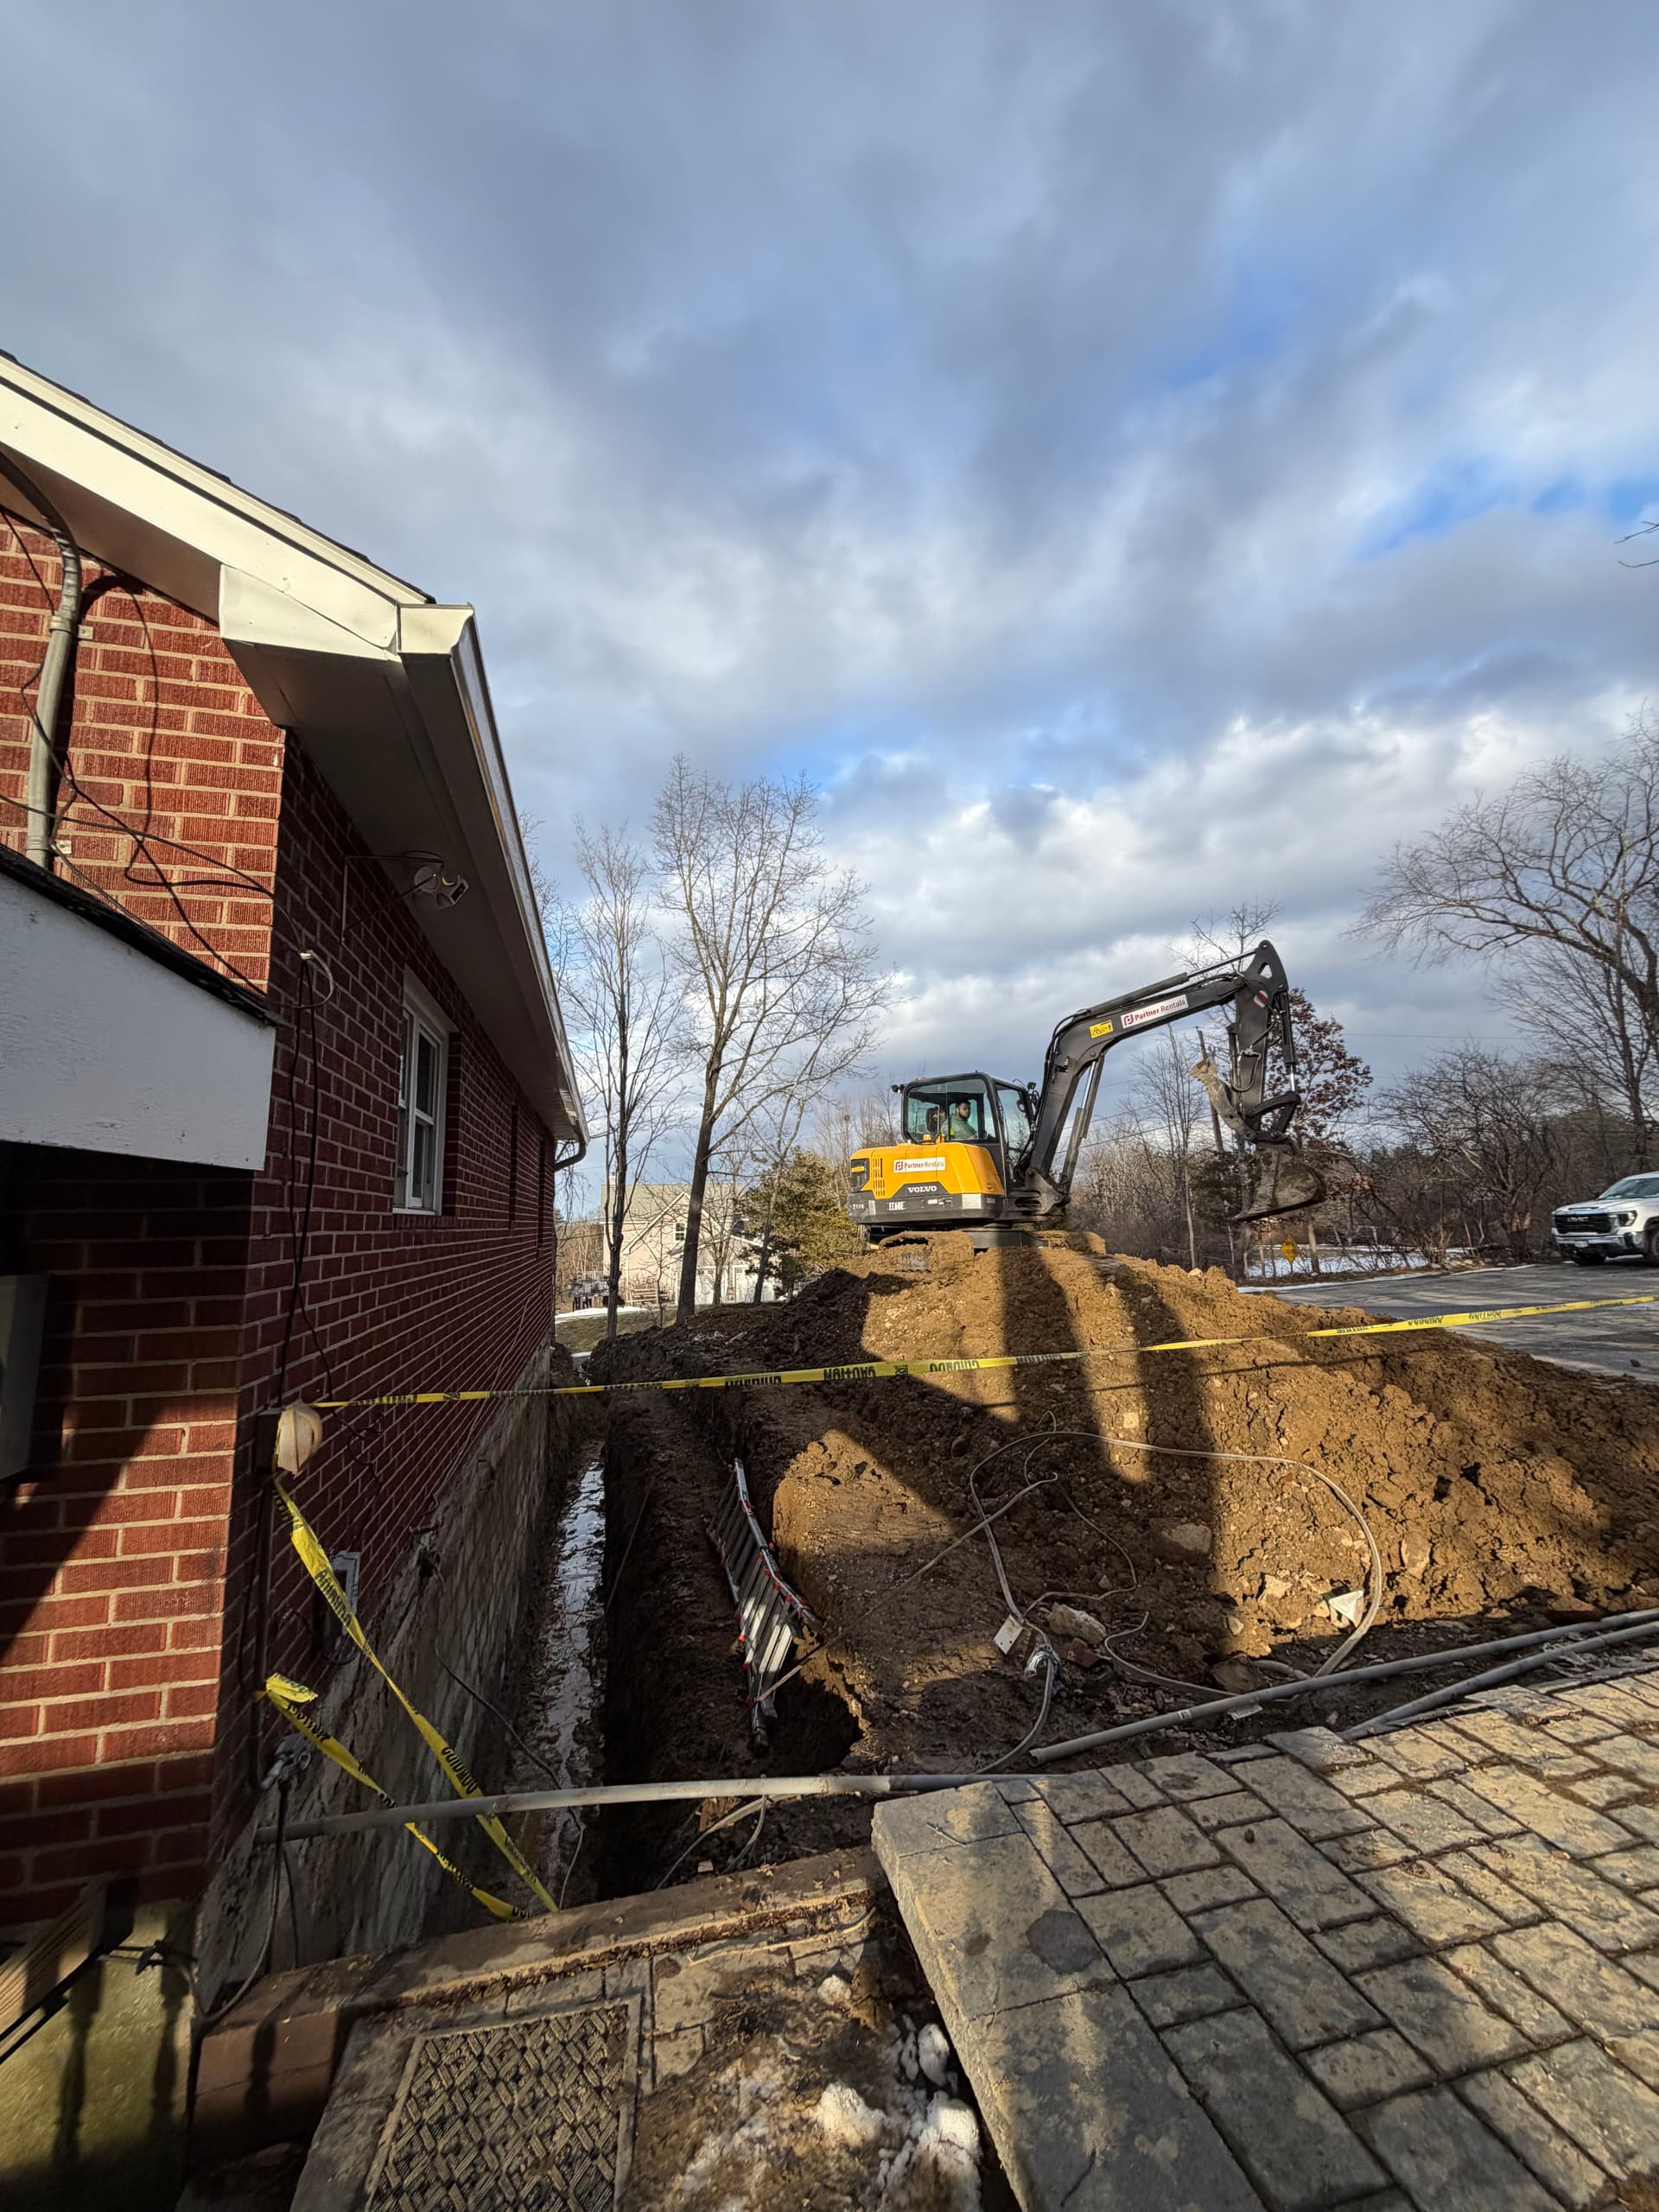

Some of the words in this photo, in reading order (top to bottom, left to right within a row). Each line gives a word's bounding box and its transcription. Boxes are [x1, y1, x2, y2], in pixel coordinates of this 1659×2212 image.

[1135, 1008, 1159, 1020] Partner
[1160, 999, 1185, 1013] Rentals
[823, 1365, 875, 1380] CAUTION
